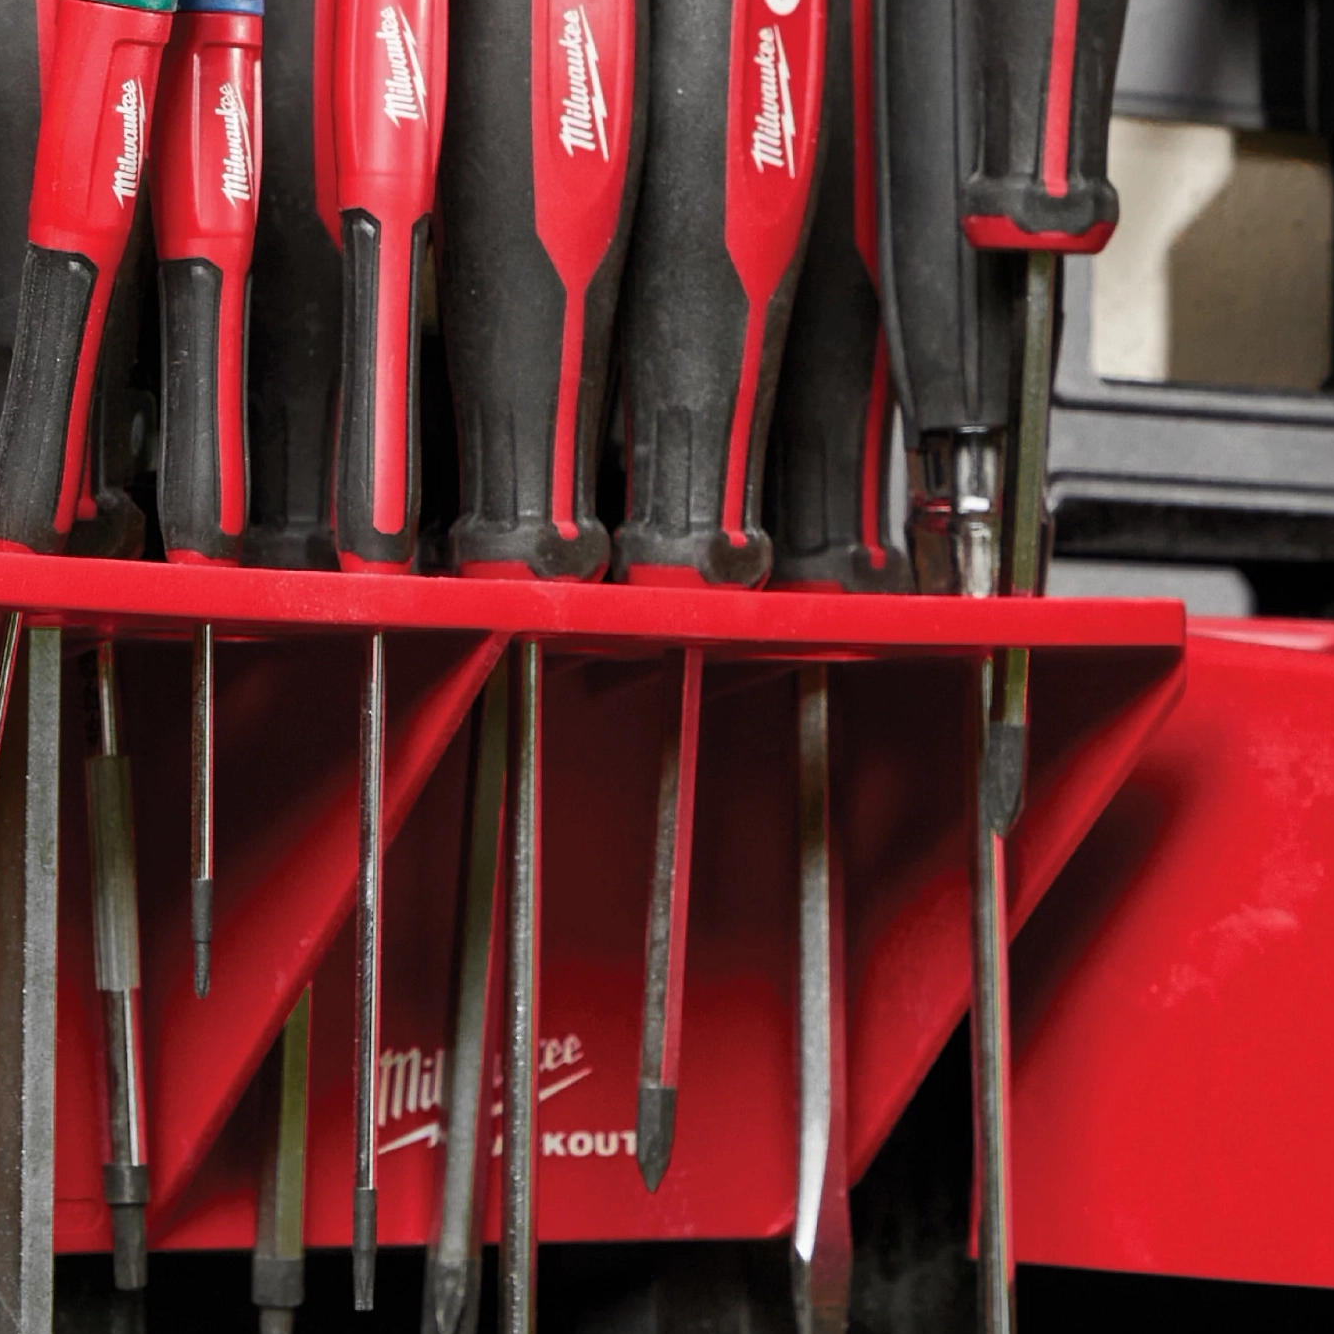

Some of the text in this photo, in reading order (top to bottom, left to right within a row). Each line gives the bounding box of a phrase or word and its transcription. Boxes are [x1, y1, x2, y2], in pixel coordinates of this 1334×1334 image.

[376, 5, 419, 128] Milwaukee
[559, 8, 596, 157] Milwaukee
[750, 26, 785, 174] Milwaukee
[111, 78, 138, 209] Milwaukee
[217, 81, 250, 209] Milwaukee
